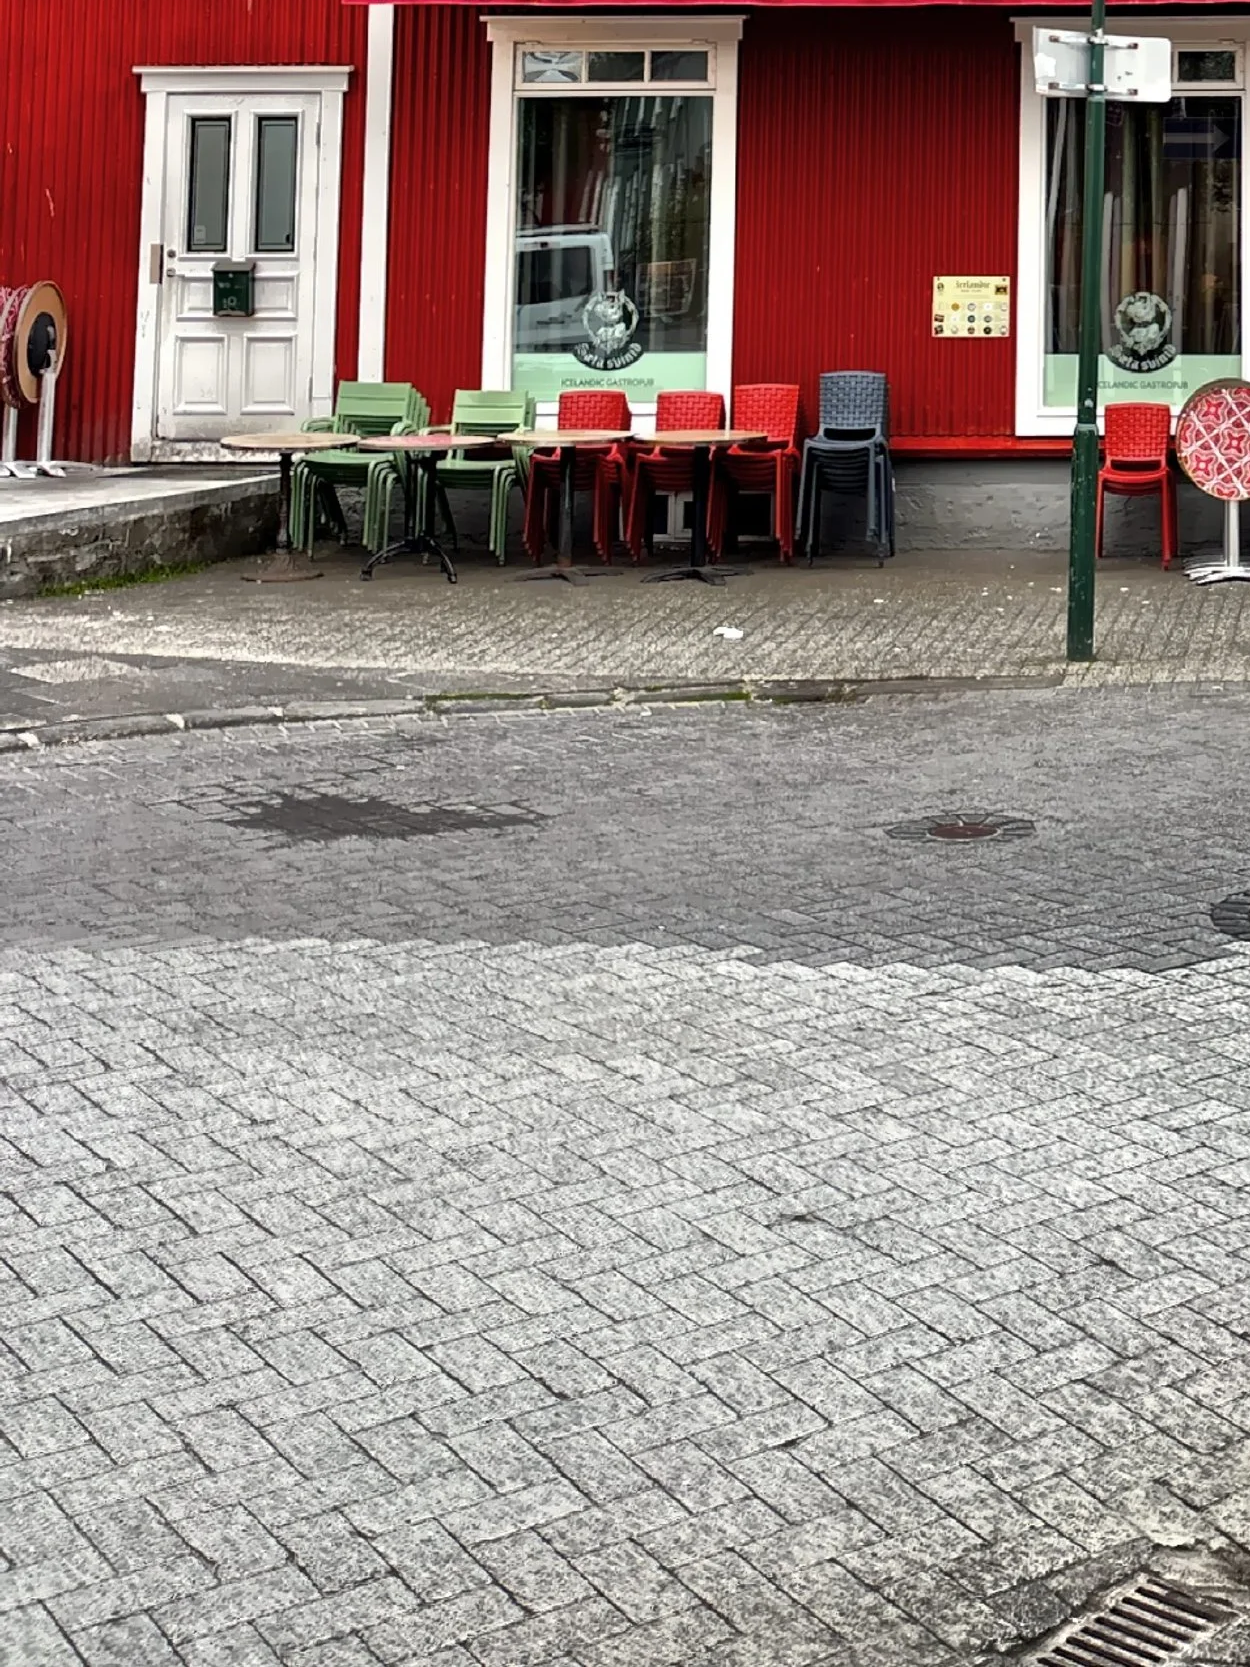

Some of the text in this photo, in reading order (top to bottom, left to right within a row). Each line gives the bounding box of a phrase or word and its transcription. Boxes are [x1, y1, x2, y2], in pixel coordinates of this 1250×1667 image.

[561, 378, 655, 387] ICELANDIC GASTROPUB
[1098, 380, 1189, 389] CELANDIC GASTROPUB
